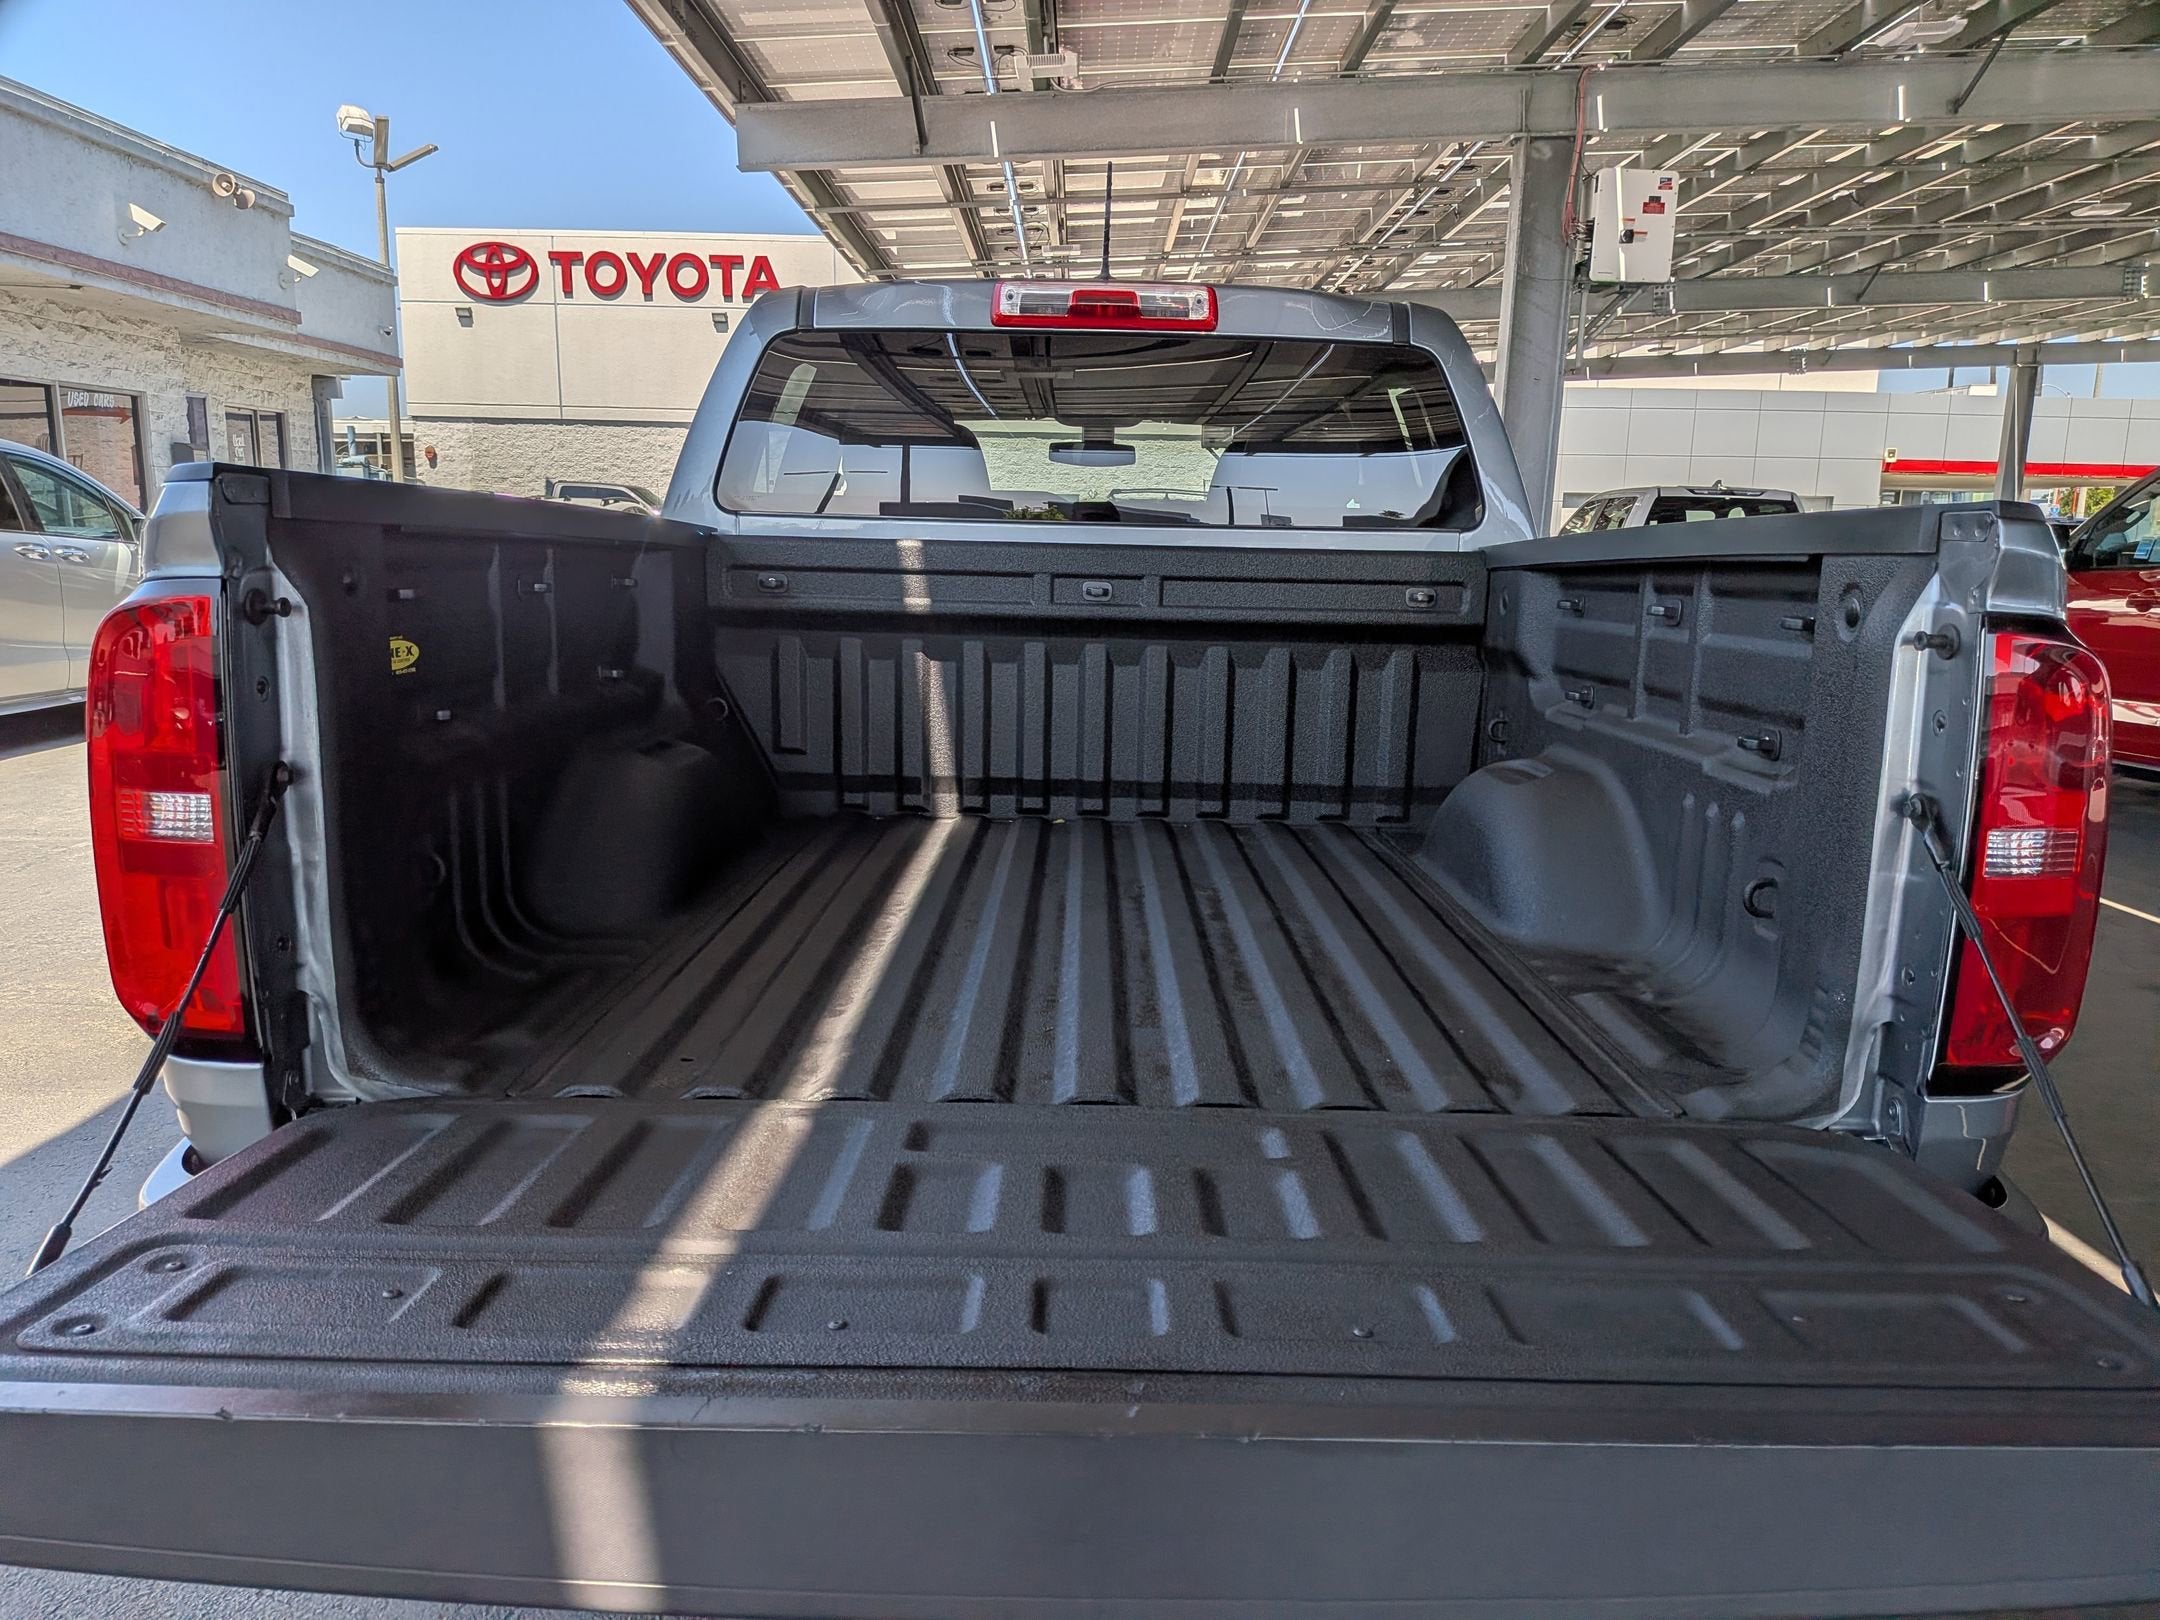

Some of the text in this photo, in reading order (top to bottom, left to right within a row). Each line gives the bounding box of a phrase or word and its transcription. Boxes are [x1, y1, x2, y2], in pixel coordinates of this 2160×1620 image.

[548, 251, 781, 299] TOYOTA
[67, 391, 115, 408] USED CARS
